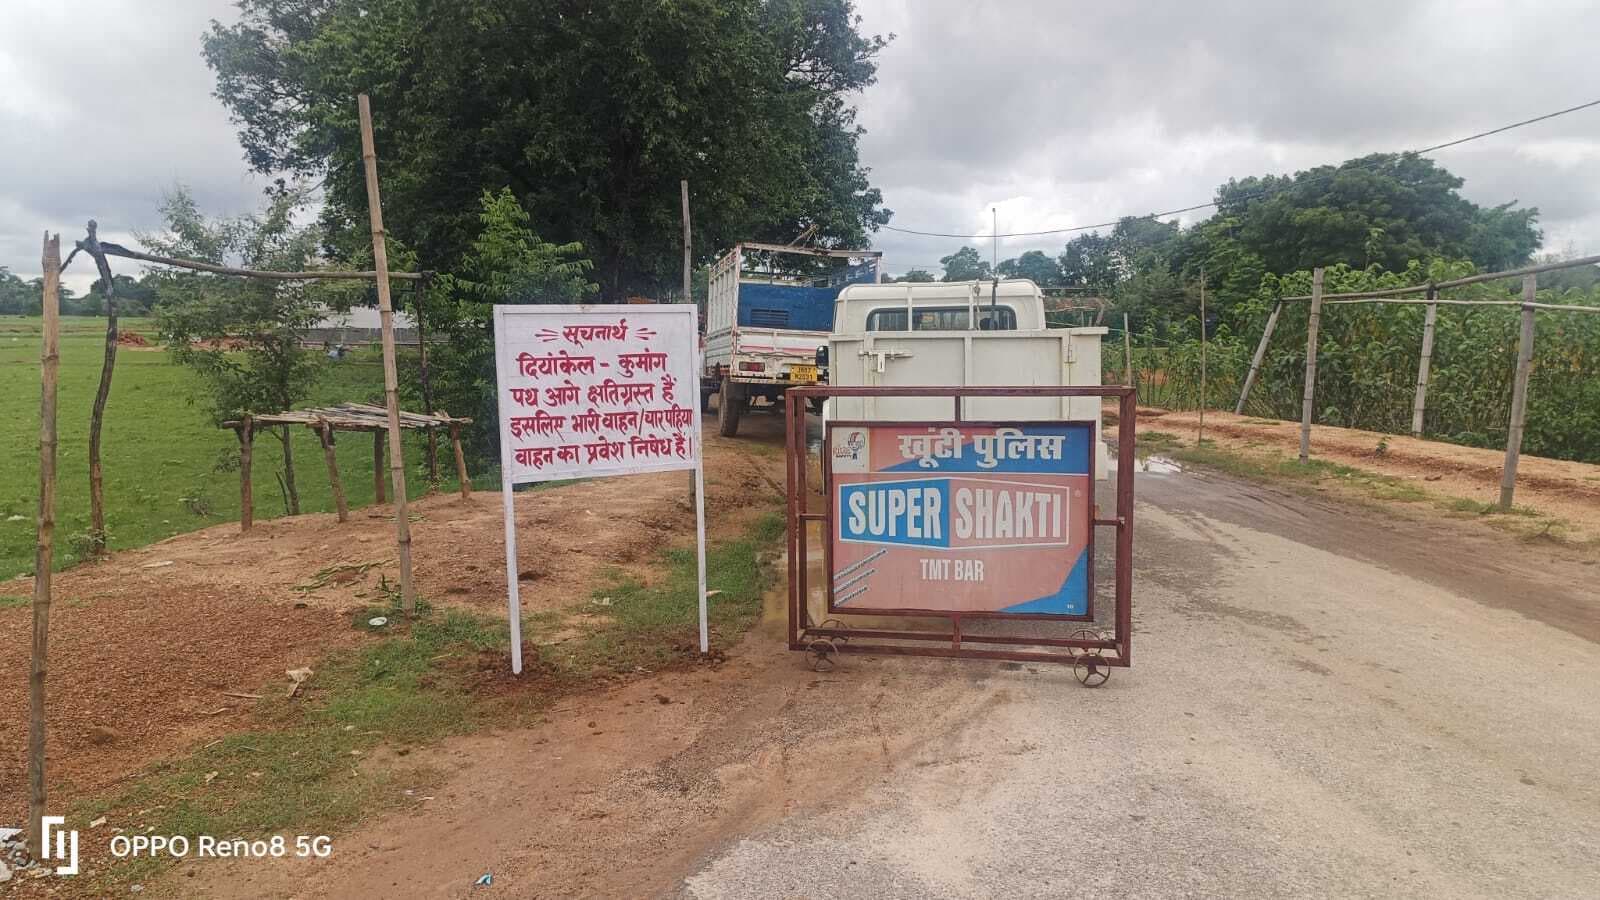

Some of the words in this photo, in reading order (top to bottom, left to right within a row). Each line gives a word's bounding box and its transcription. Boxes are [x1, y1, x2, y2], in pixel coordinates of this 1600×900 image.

[562, 318, 628, 348] सूचनार्थ
[509, 387, 540, 407] पथ
[543, 379, 581, 406] आगे
[587, 379, 655, 406] क्षतिग्रस्त
[510, 409, 567, 441] इसलिए
[571, 408, 601, 434] भारी
[514, 446, 555, 470] वाहन
[557, 444, 580, 464] का
[584, 435, 625, 465] प्रवेश
[628, 434, 673, 459] निषेध
[897, 427, 965, 468] खूंटी
[972, 427, 1066, 469] पुलिस
[848, 487, 942, 540] SUPER
[955, 487, 1061, 539] SHAKTI
[920, 559, 950, 581] TMT
[954, 559, 985, 582] BAR
